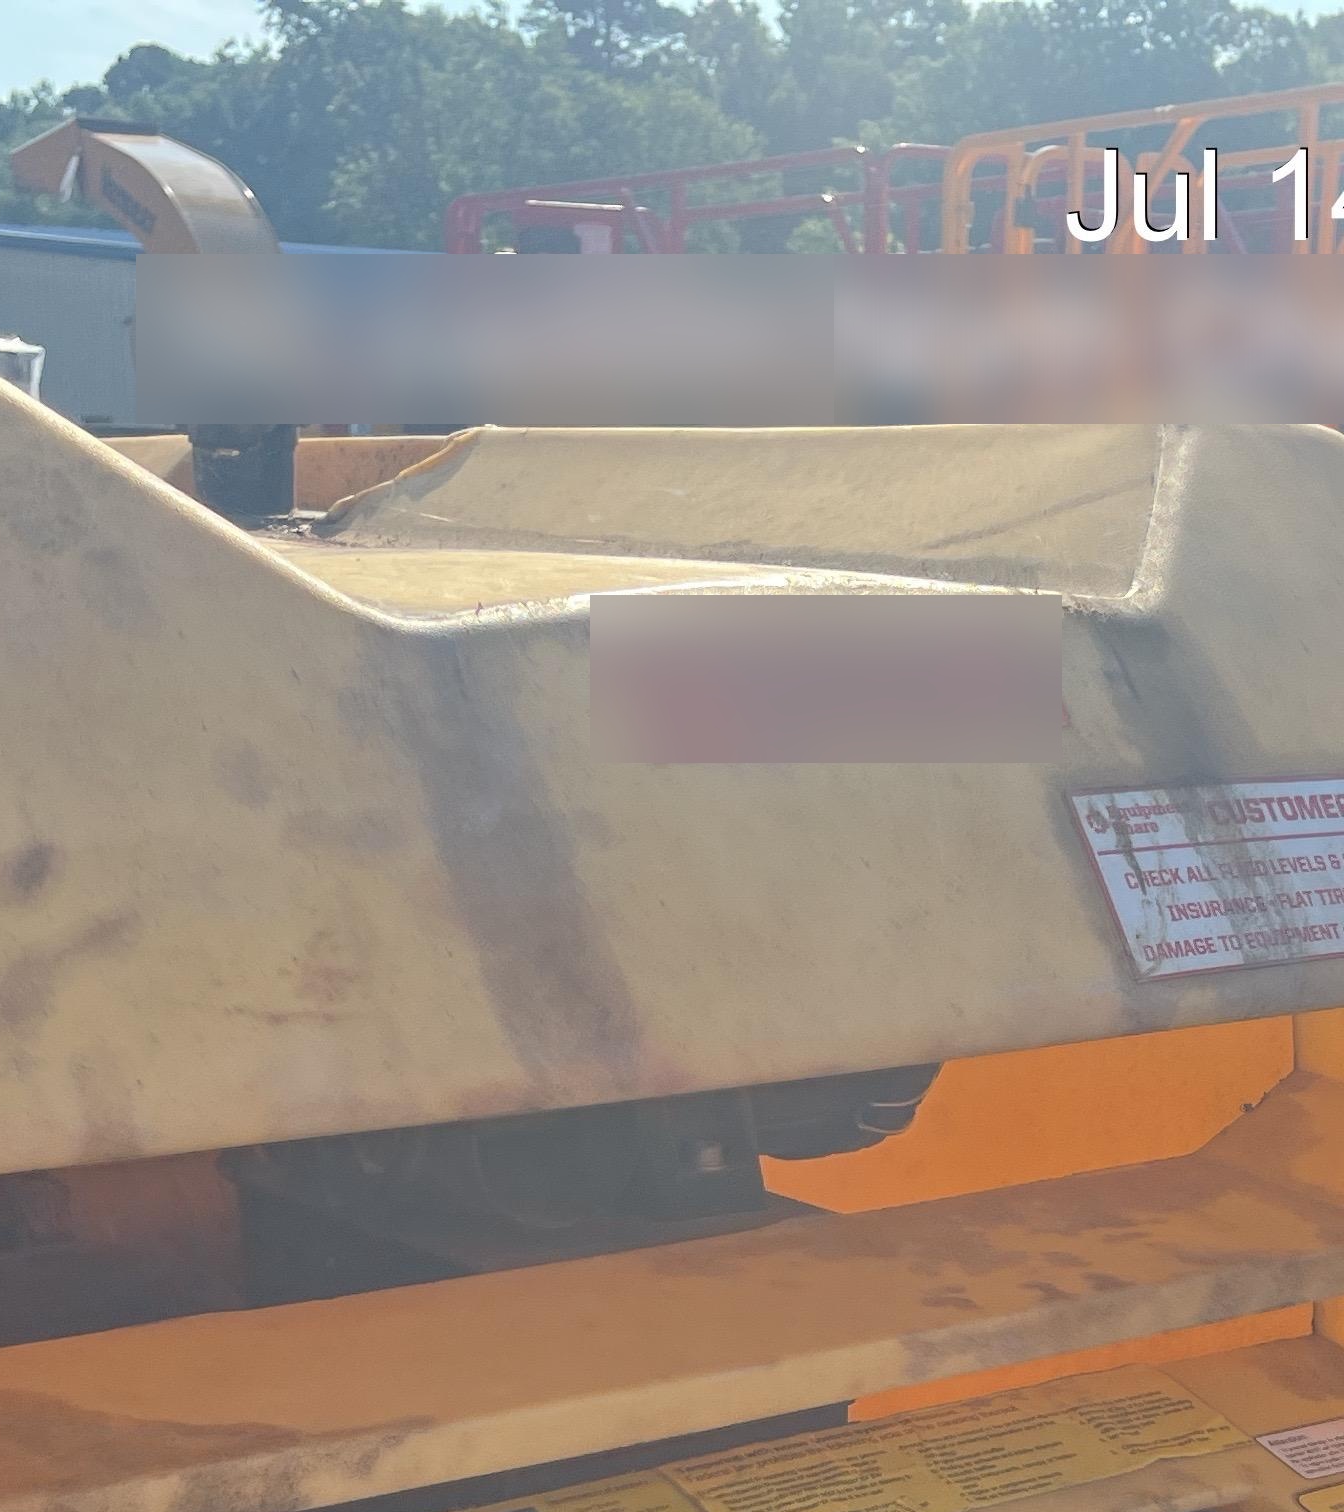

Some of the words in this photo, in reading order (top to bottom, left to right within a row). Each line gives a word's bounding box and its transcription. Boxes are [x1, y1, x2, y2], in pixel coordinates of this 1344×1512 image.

[1271, 854, 1327, 875] LEVELS
[1143, 936, 1218, 962] DAMAGE
[1218, 934, 1243, 952] TO
